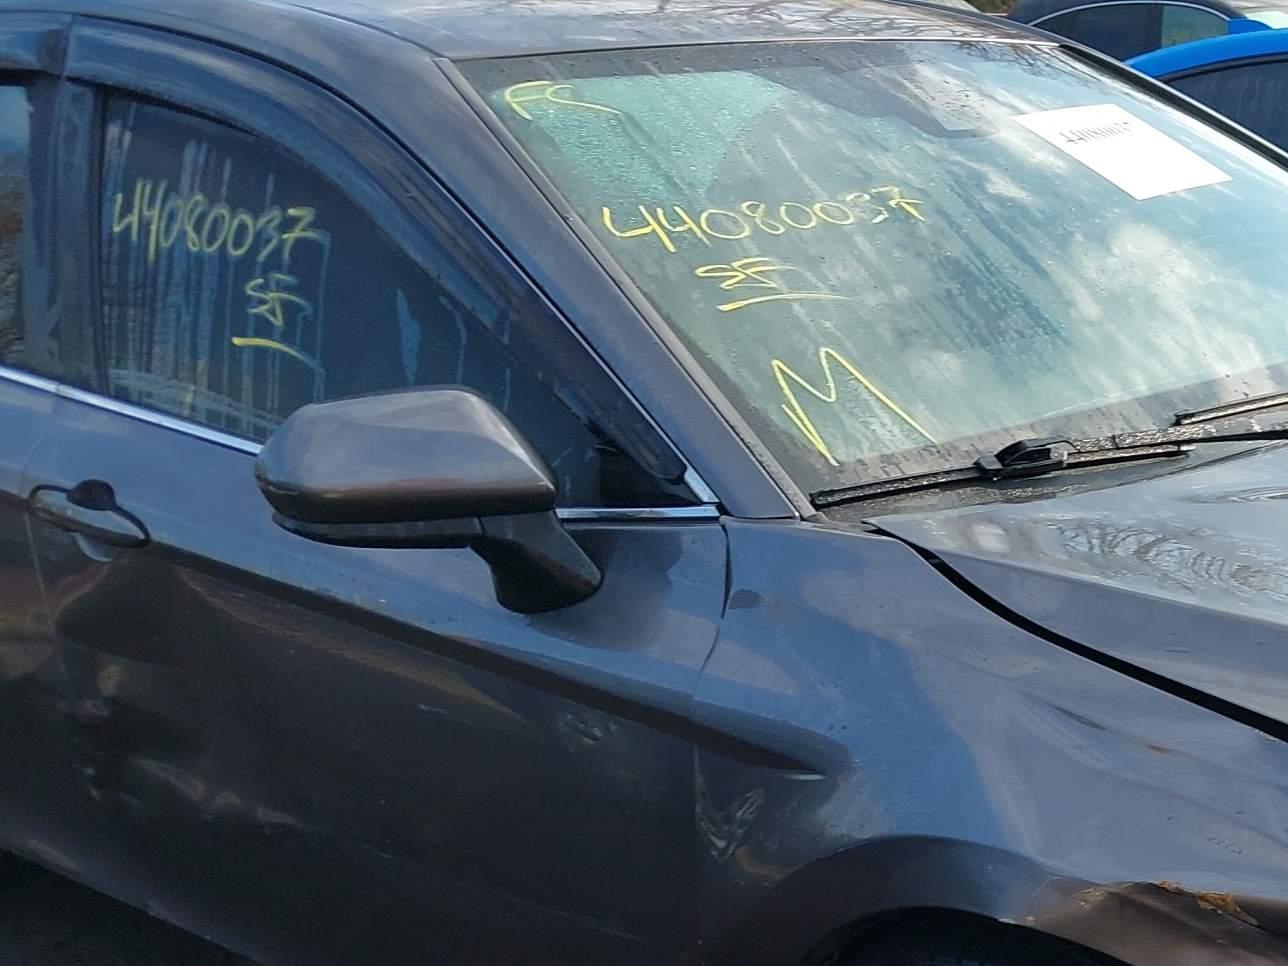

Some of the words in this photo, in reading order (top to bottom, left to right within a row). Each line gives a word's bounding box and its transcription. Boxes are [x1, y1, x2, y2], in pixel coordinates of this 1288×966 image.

[112, 178, 322, 265] 44080037
[601, 186, 925, 253] 44080037
[771, 347, 938, 467] M
